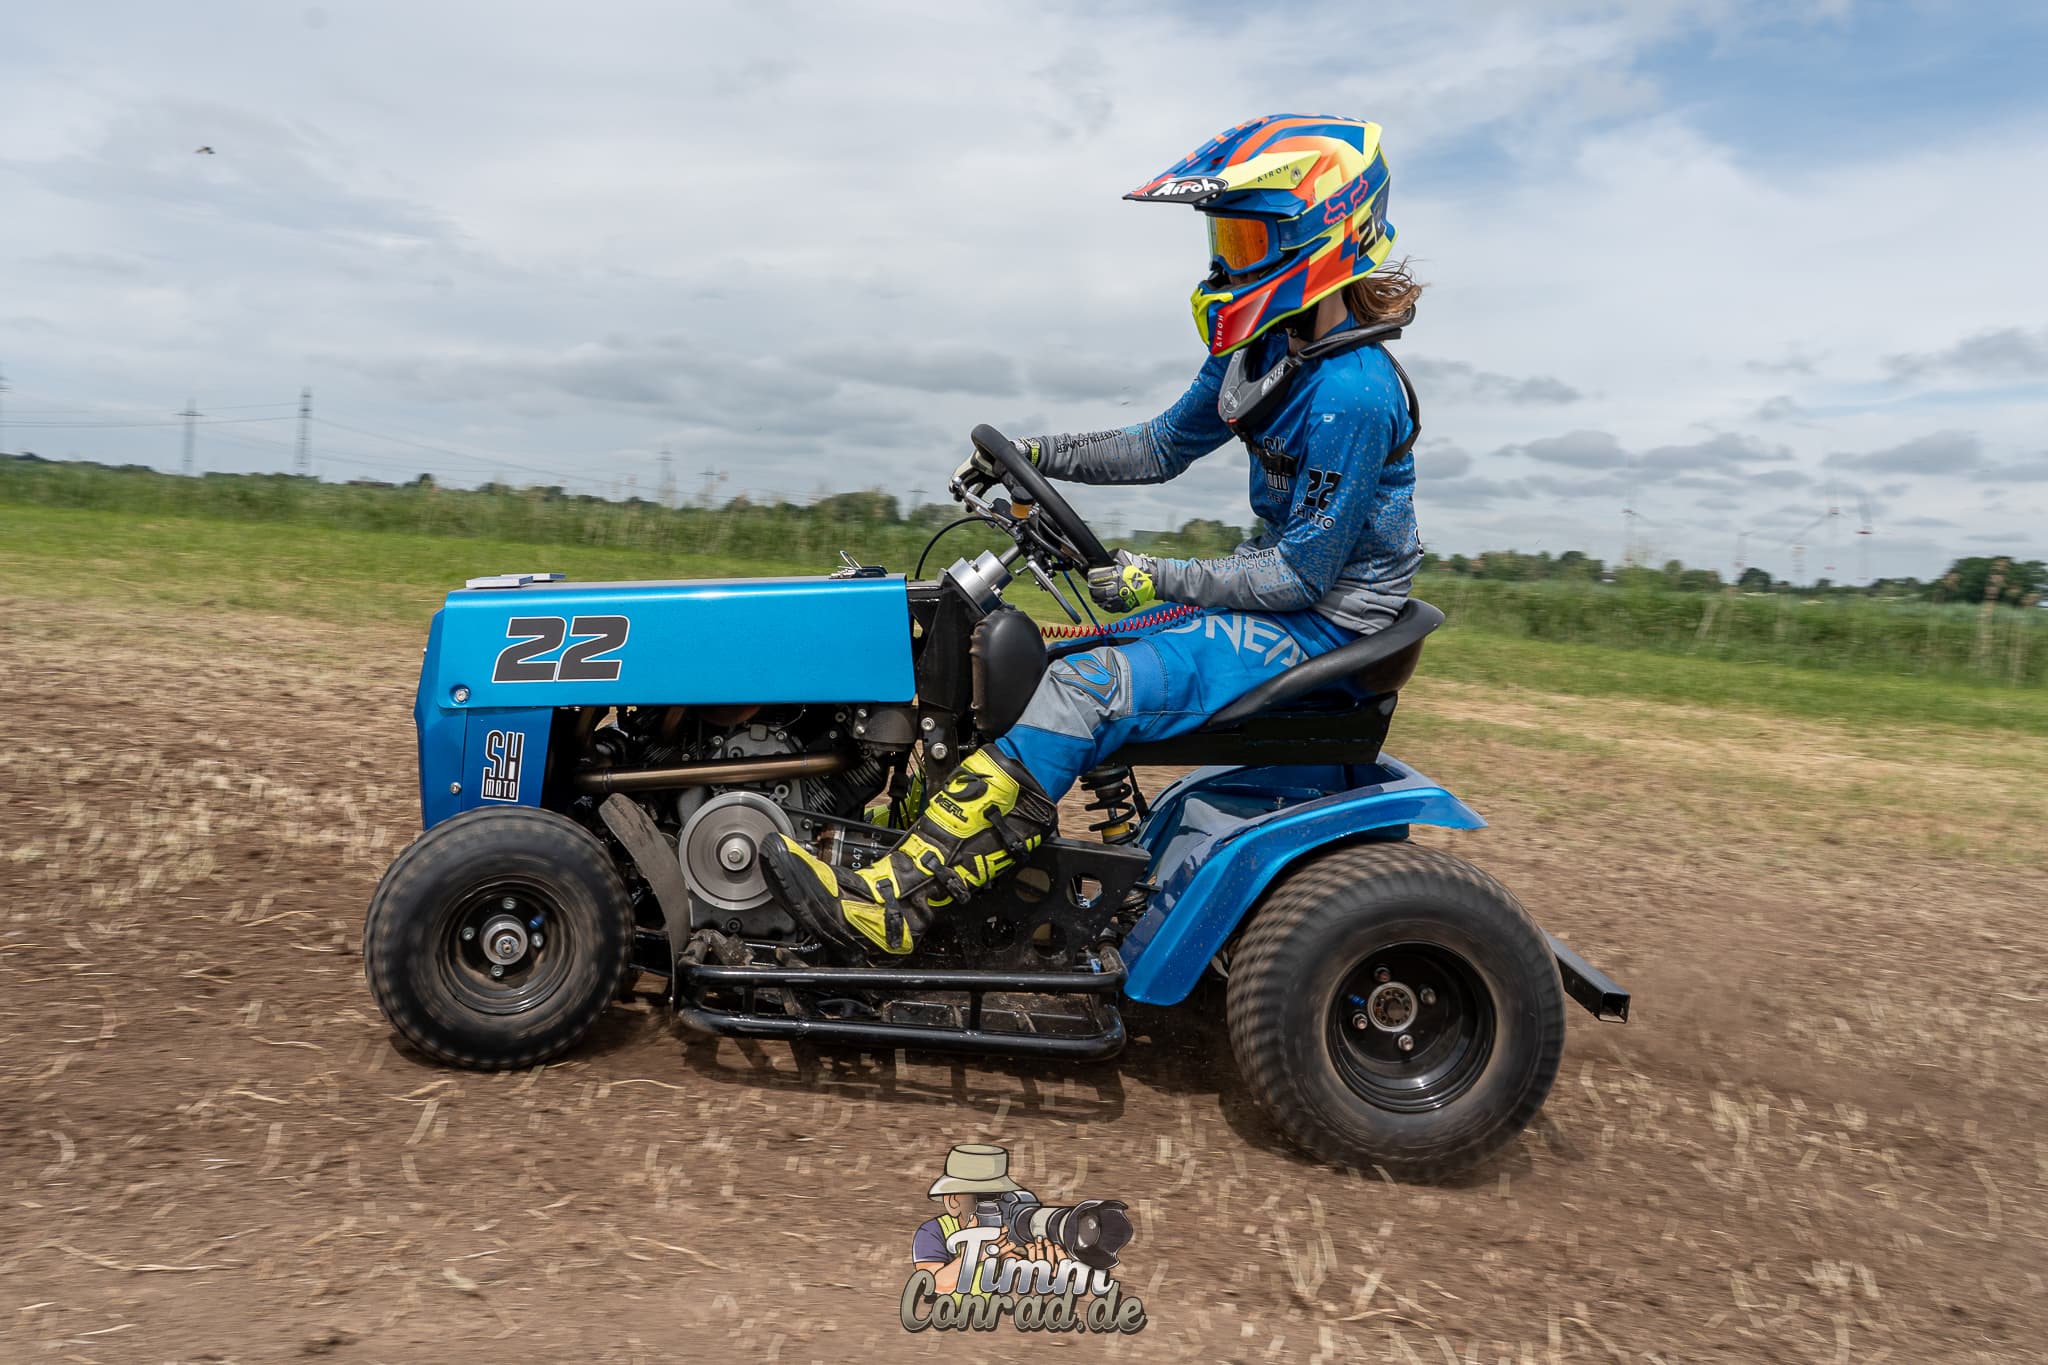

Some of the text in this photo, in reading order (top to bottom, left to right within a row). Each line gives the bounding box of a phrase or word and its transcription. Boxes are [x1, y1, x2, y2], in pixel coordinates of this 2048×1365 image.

[1152, 178, 1220, 197] Airoh
[1257, 164, 1289, 182] AIROH
[1302, 467, 1343, 512] 22
[492, 615, 630, 683] 22
[484, 730, 525, 780] SH
[485, 778, 516, 799] MOTO
